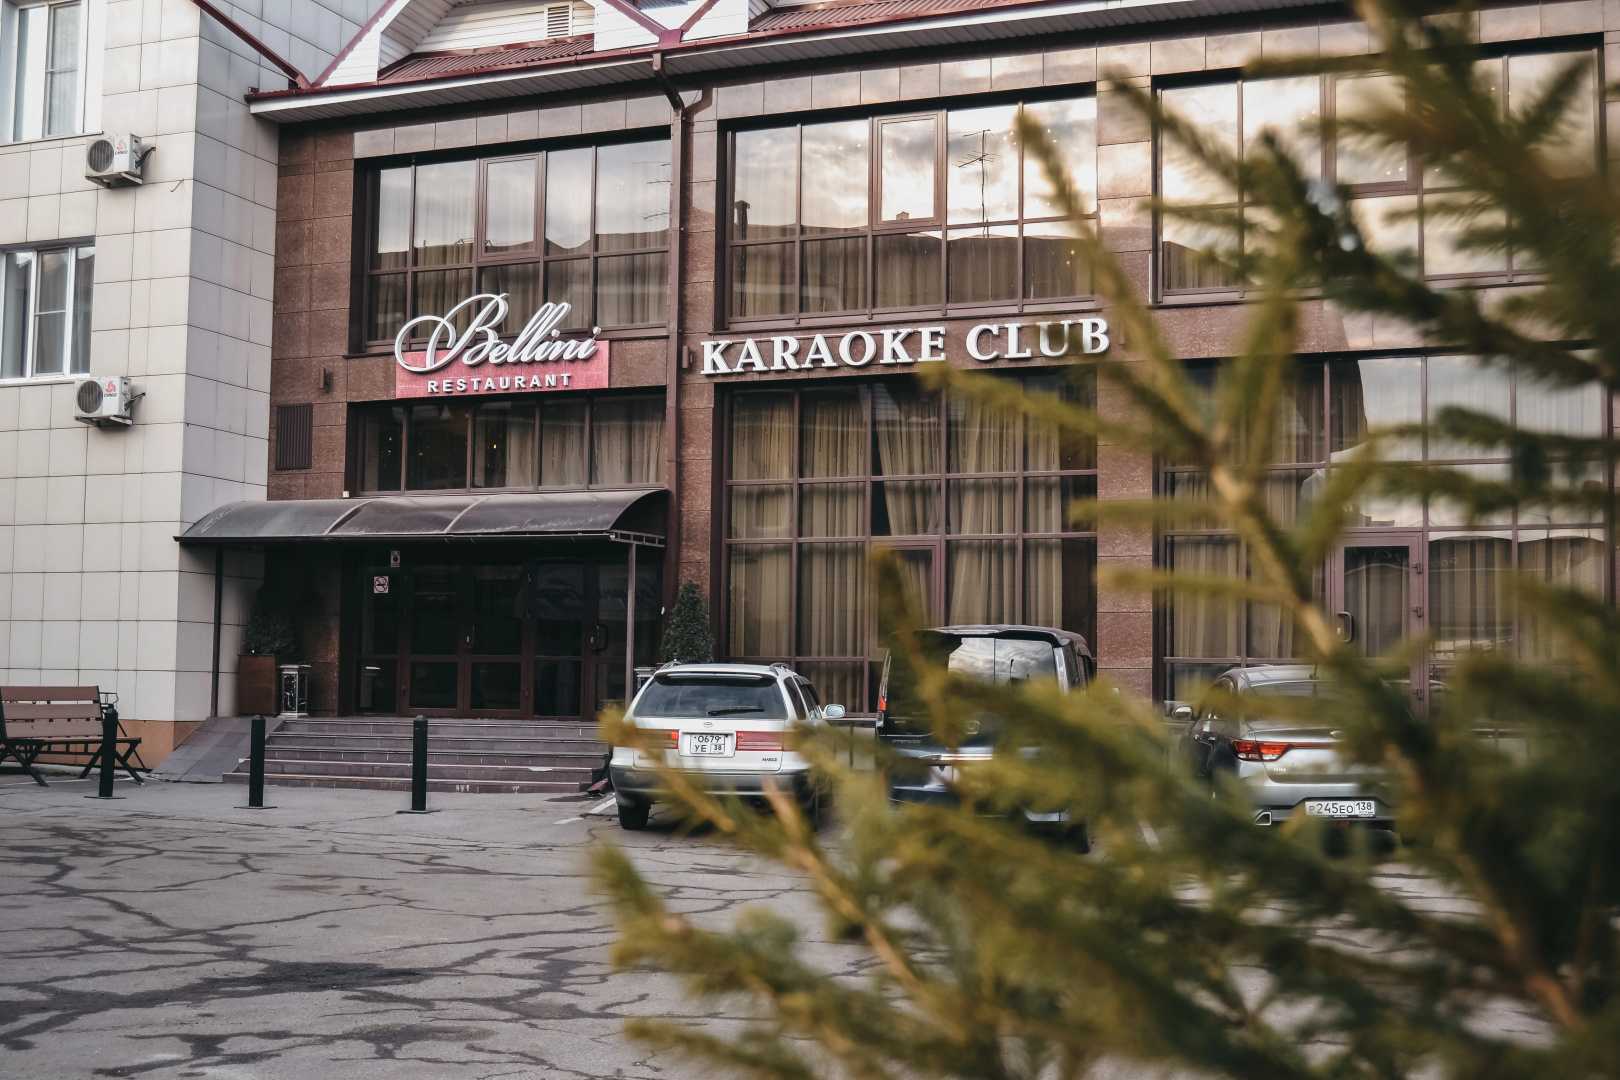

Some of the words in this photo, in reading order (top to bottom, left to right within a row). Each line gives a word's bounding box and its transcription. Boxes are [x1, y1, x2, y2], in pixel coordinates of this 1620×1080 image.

[394, 292, 602, 372] Bellini
[700, 326, 947, 375] KARAOKE
[966, 318, 1110, 362] CLUB
[427, 373, 571, 393] RESTAURANT
[1355, 802, 1372, 810] 138
